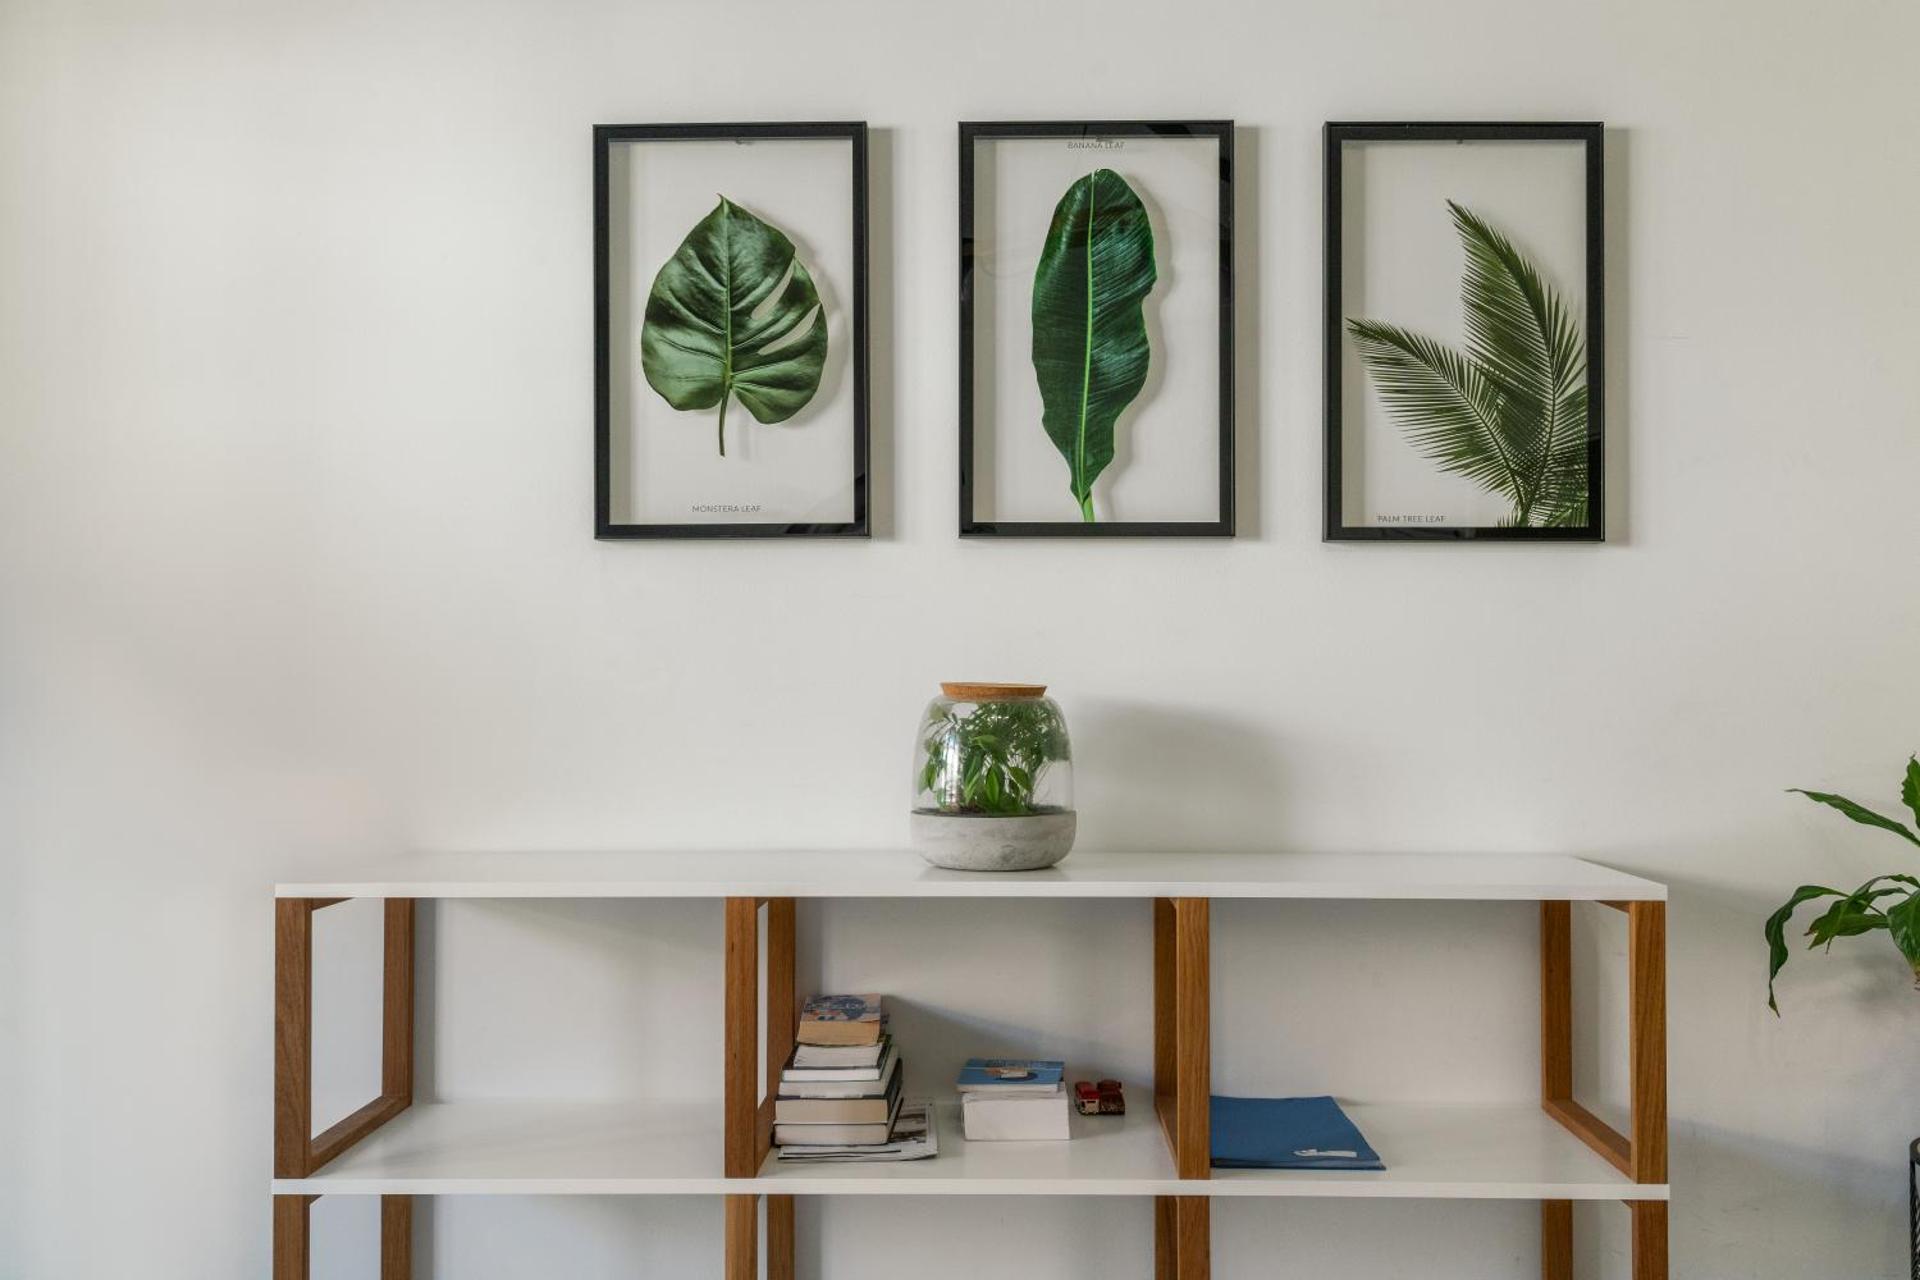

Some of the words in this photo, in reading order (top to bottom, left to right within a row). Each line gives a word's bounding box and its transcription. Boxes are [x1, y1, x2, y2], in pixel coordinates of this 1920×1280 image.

[1067, 141, 1102, 149] BANANA
[1104, 141, 1125, 149] LEAF
[691, 504, 739, 513] MONSTERA
[741, 504, 761, 513] LEAF
[1377, 514, 1400, 523] PALM
[1402, 514, 1423, 523] TREE
[1425, 514, 1447, 523] LEAF
